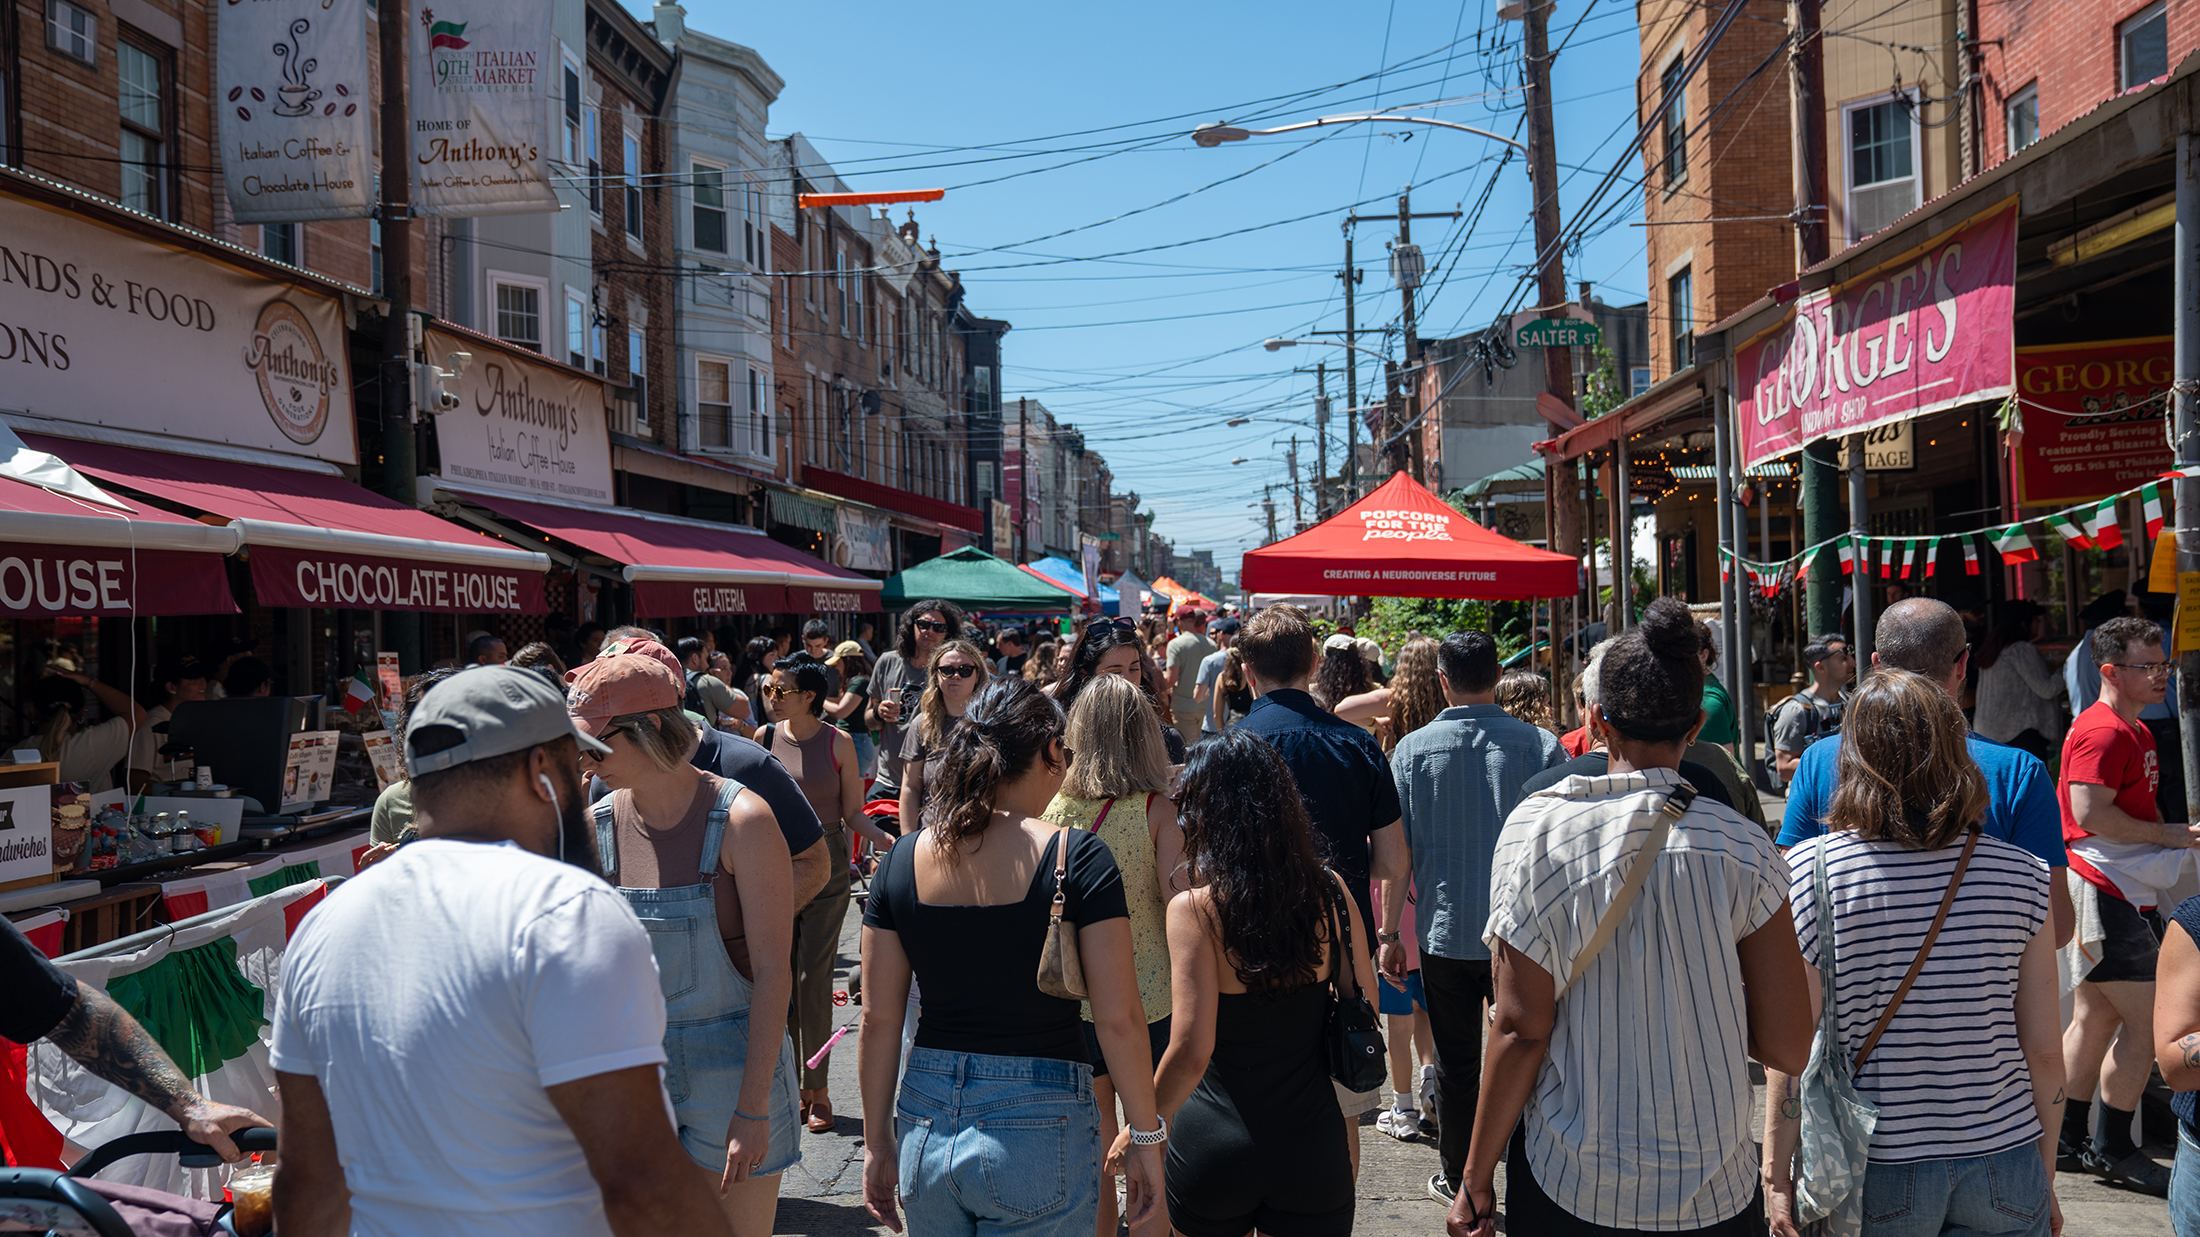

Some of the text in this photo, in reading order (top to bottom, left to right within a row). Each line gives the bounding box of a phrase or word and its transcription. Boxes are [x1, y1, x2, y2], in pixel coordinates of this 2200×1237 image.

[450, 52, 475, 60] SOUTH
[476, 51, 537, 67] ITALIAN
[437, 59, 470, 85] 9TH
[447, 76, 474, 85] STREET
[474, 68, 537, 85] MARKET
[438, 84, 535, 94] PHILADELPHIA
[416, 119, 472, 131] HOME OF
[240, 138, 350, 162] Italian Coffee &
[418, 137, 538, 170] Anthony's
[243, 171, 354, 196] Chocolate House
[420, 176, 442, 188] Italian
[443, 176, 471, 188] Coffee
[481, 175, 518, 187] Chocolate
[91, 273, 118, 309] &
[124, 280, 216, 332] FOOD
[1551, 319, 1560, 327] W
[1520, 329, 1597, 347] SALTER ST
[1755, 241, 1963, 427] GEORGE'S
[244, 334, 339, 397] Anthony's
[2022, 356, 2174, 395] GEORG
[288, 402, 305, 413] FOUR
[475, 361, 578, 452] Anthony's
[1841, 397, 1868, 424] SHOP
[2060, 429, 2107, 442] Proudly
[2109, 425, 2157, 438] Serving
[486, 424, 576, 476] Italian Coffee House
[2038, 443, 2092, 457] Featured
[2094, 444, 2110, 452] on
[2113, 439, 2157, 450] Bizarre
[1838, 450, 1910, 468] VTAGE
[2053, 464, 2073, 474] 900
[2074, 462, 2086, 472] S.
[2087, 461, 2105, 471] 9th
[2108, 459, 2123, 469] St.
[1360, 510, 1450, 524] POPCORN
[1365, 520, 1446, 532] FOR THE
[0, 556, 132, 610] OUSE
[1323, 569, 1497, 581] CREATING A NEURODIVERSE FUTURE
[297, 560, 521, 610] CHOCOLATE HOUSE
[693, 587, 748, 613] GELATERIA
[813, 592, 832, 612] OPEN
